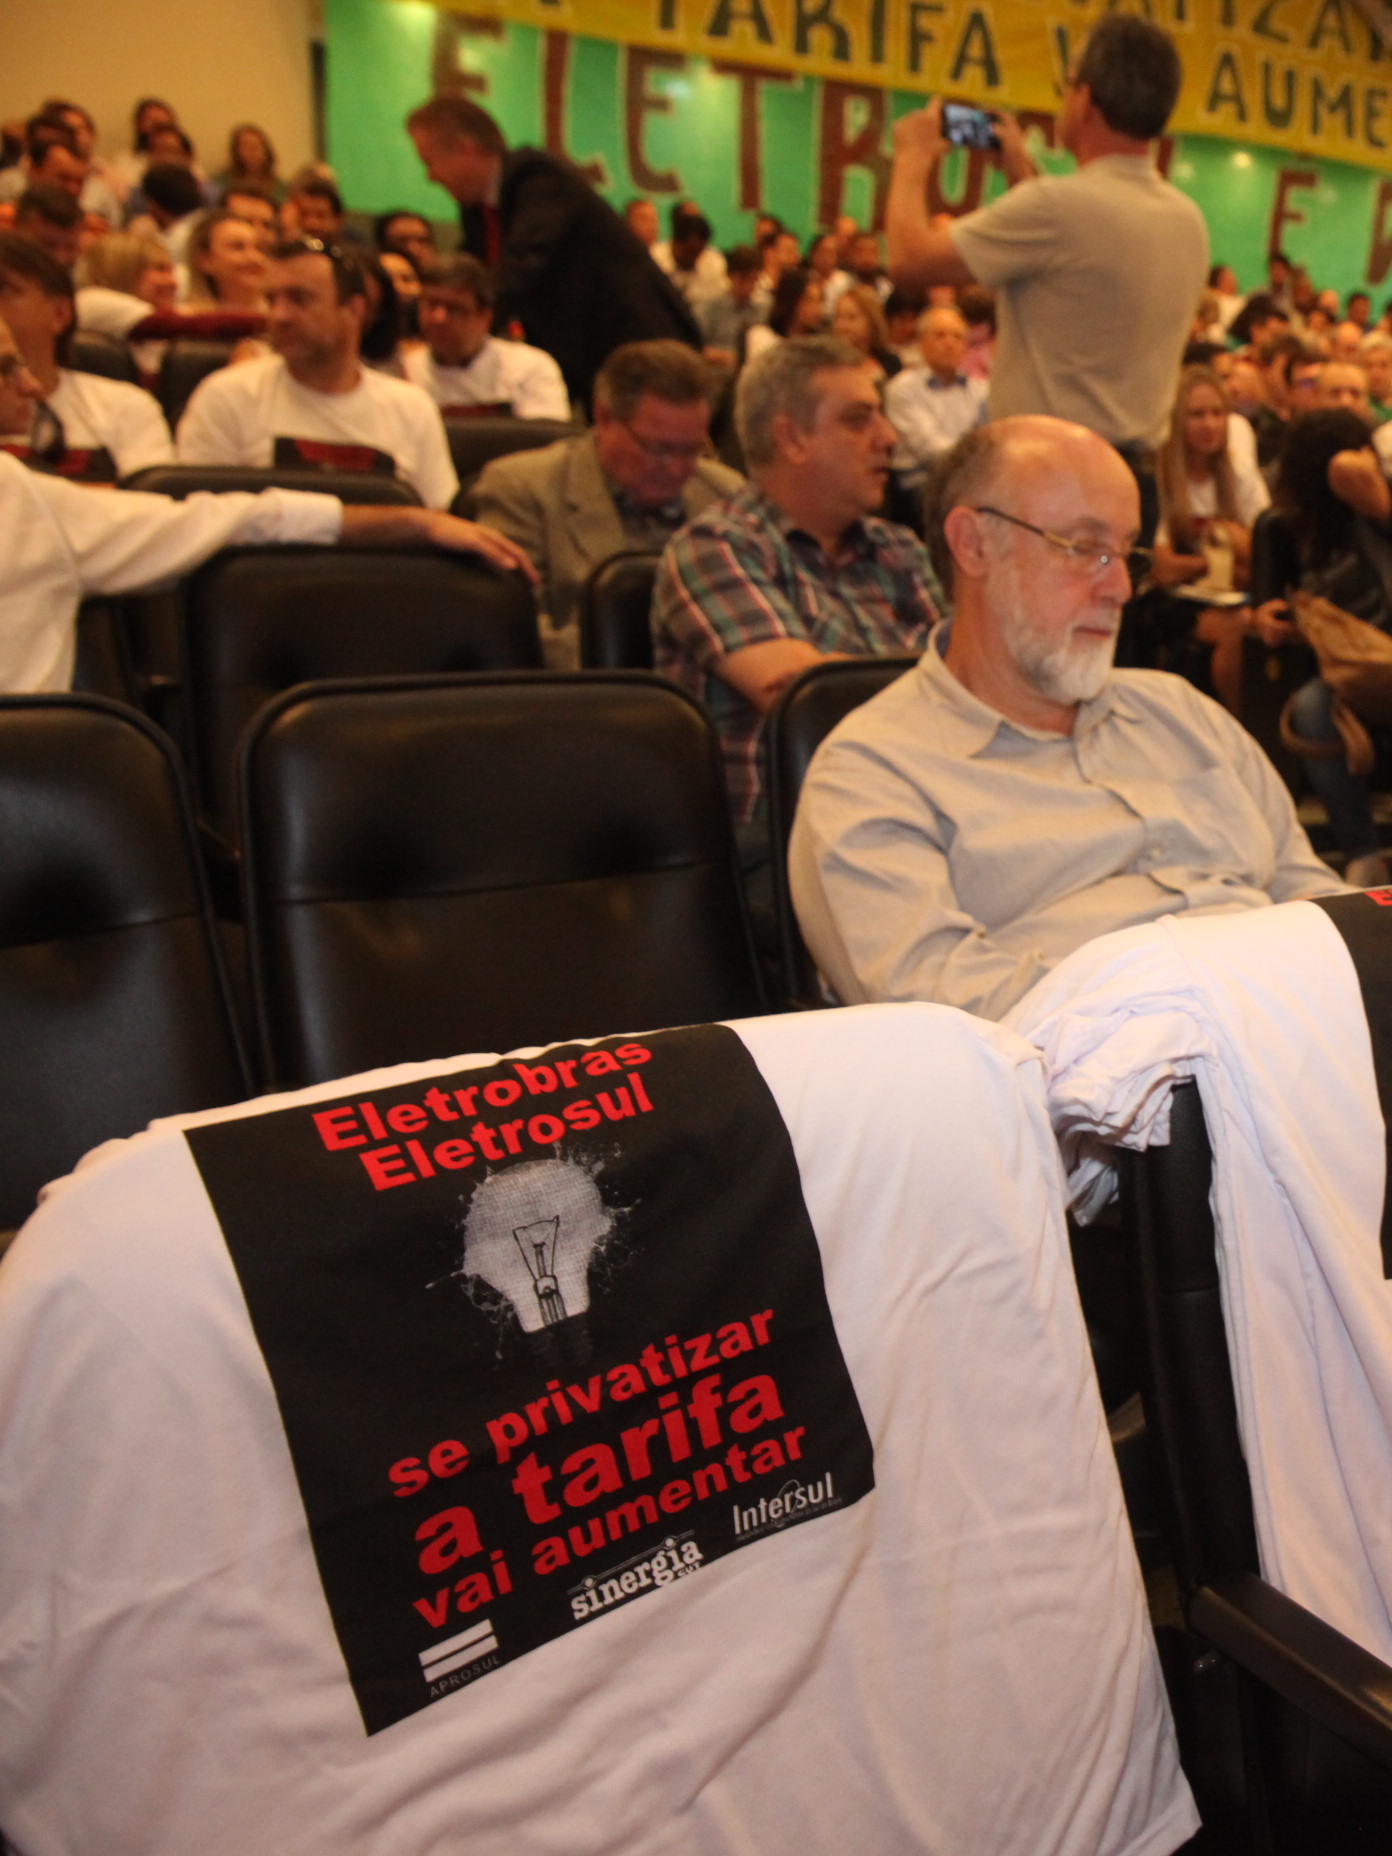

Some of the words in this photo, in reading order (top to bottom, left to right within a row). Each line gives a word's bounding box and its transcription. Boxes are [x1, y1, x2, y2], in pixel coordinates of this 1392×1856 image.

[311, 1043, 652, 1151] Eletrobras
[358, 1072, 654, 1191] Eletrosul
[388, 1439, 469, 1497] se
[486, 1309, 774, 1463] privatizar
[412, 1549, 512, 1628] vai
[532, 1426, 805, 1575] aumentar
[414, 1506, 483, 1574] a
[511, 1374, 785, 1524] tarifa
[733, 1471, 833, 1535] Intersul
[571, 1536, 704, 1620] sinergia
[430, 1655, 501, 1698] APROSUL
